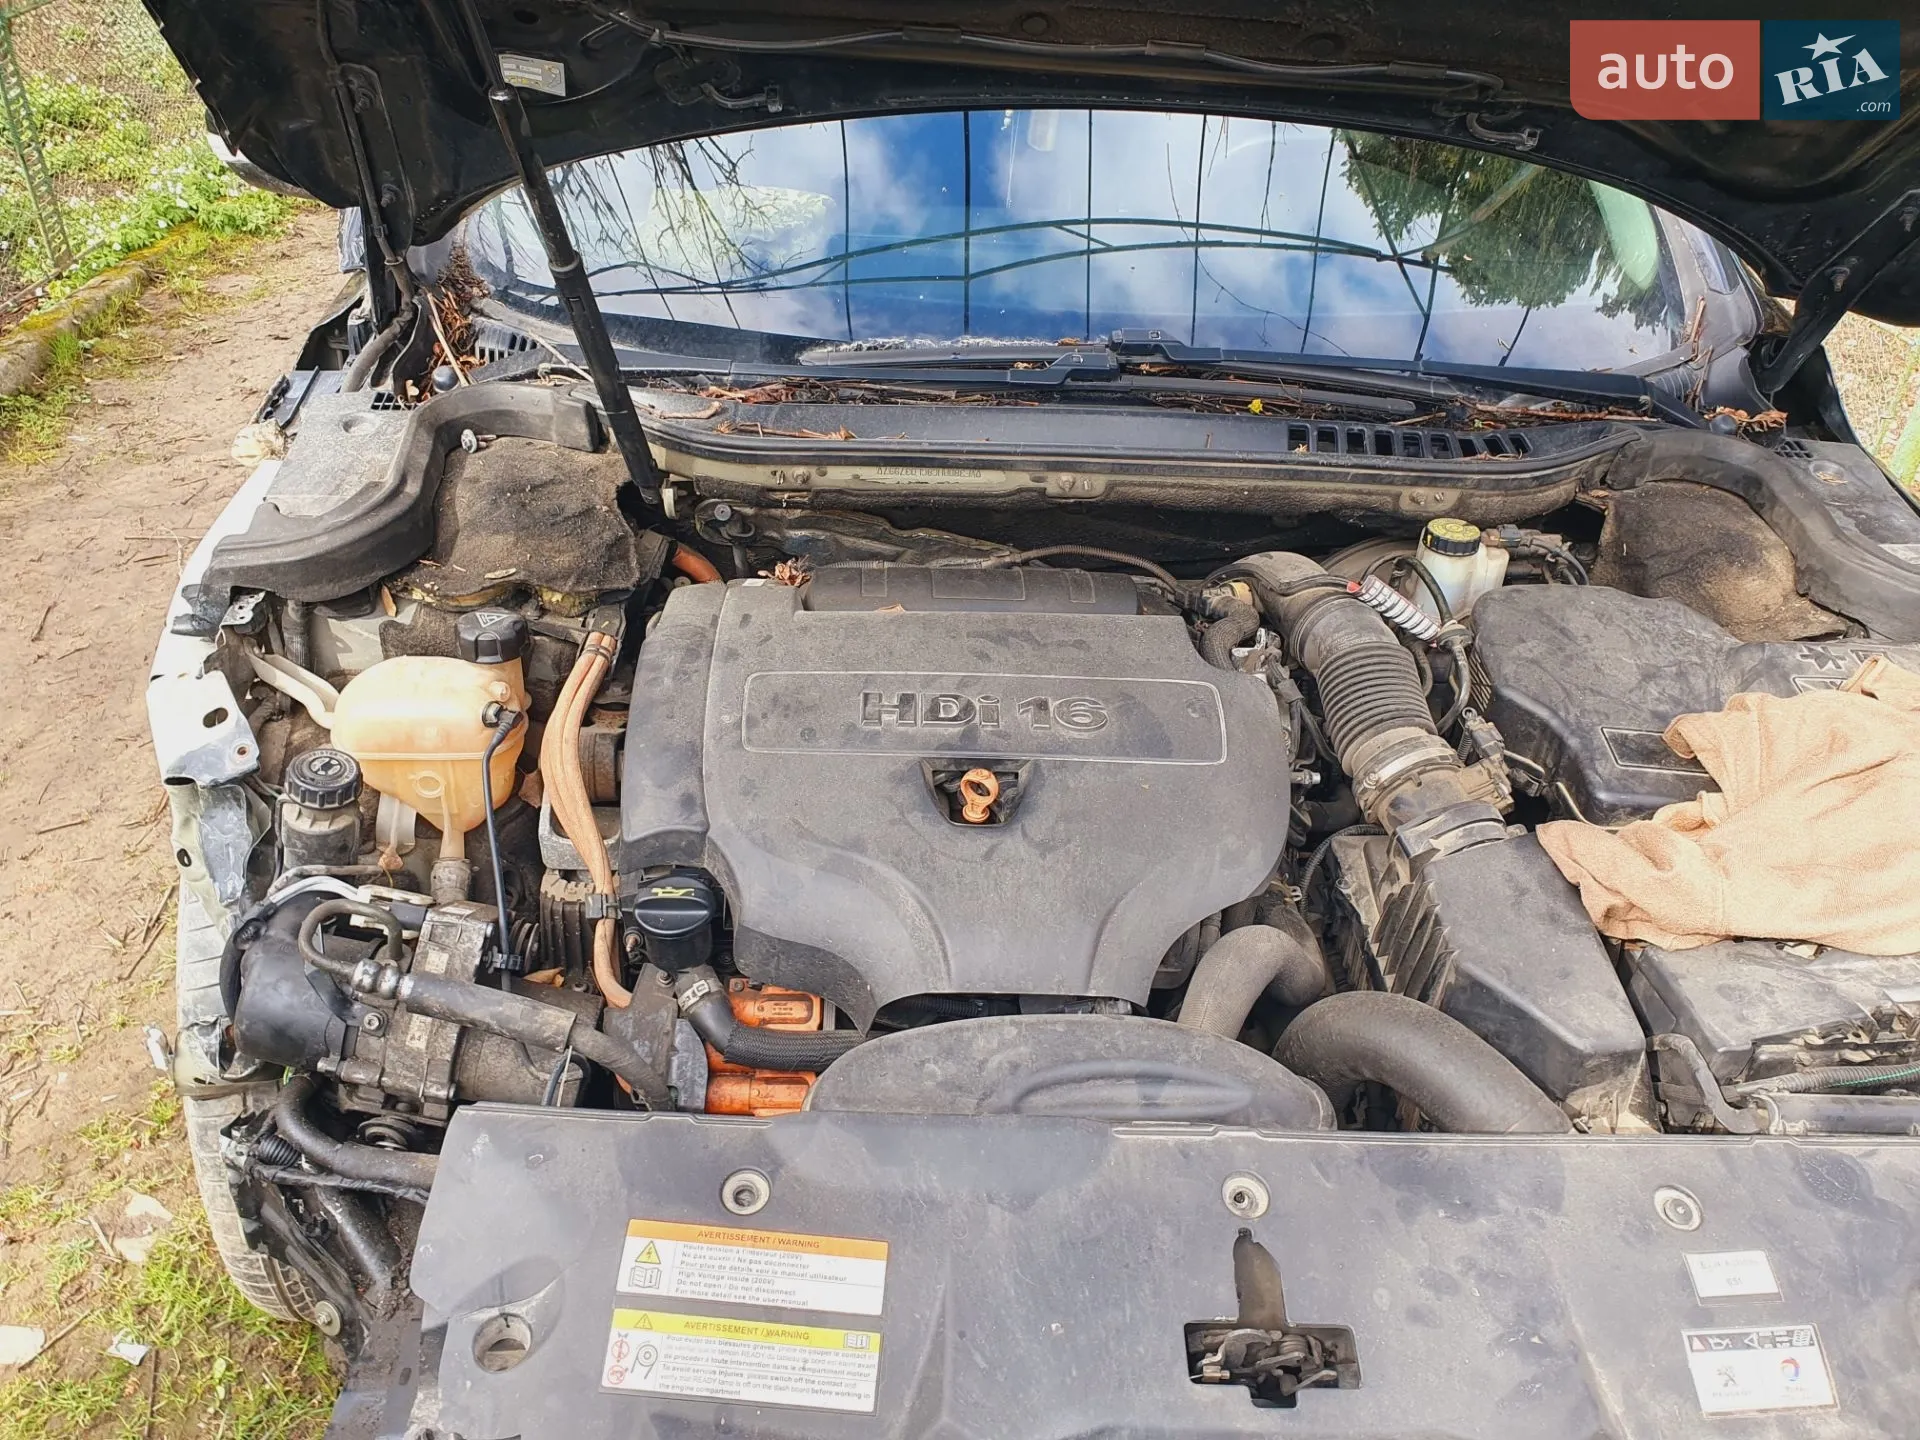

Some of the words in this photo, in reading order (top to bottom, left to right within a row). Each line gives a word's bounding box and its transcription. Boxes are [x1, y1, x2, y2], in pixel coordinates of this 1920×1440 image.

[859, 691, 1000, 729] HDi
[1017, 696, 1109, 731] 16
[697, 1230, 770, 1243] AVERTISSEMENT
[778, 1237, 820, 1248] WARNING
[684, 1320, 760, 1334] AVERTISSEMENT
[766, 1328, 810, 1339] WARNING
